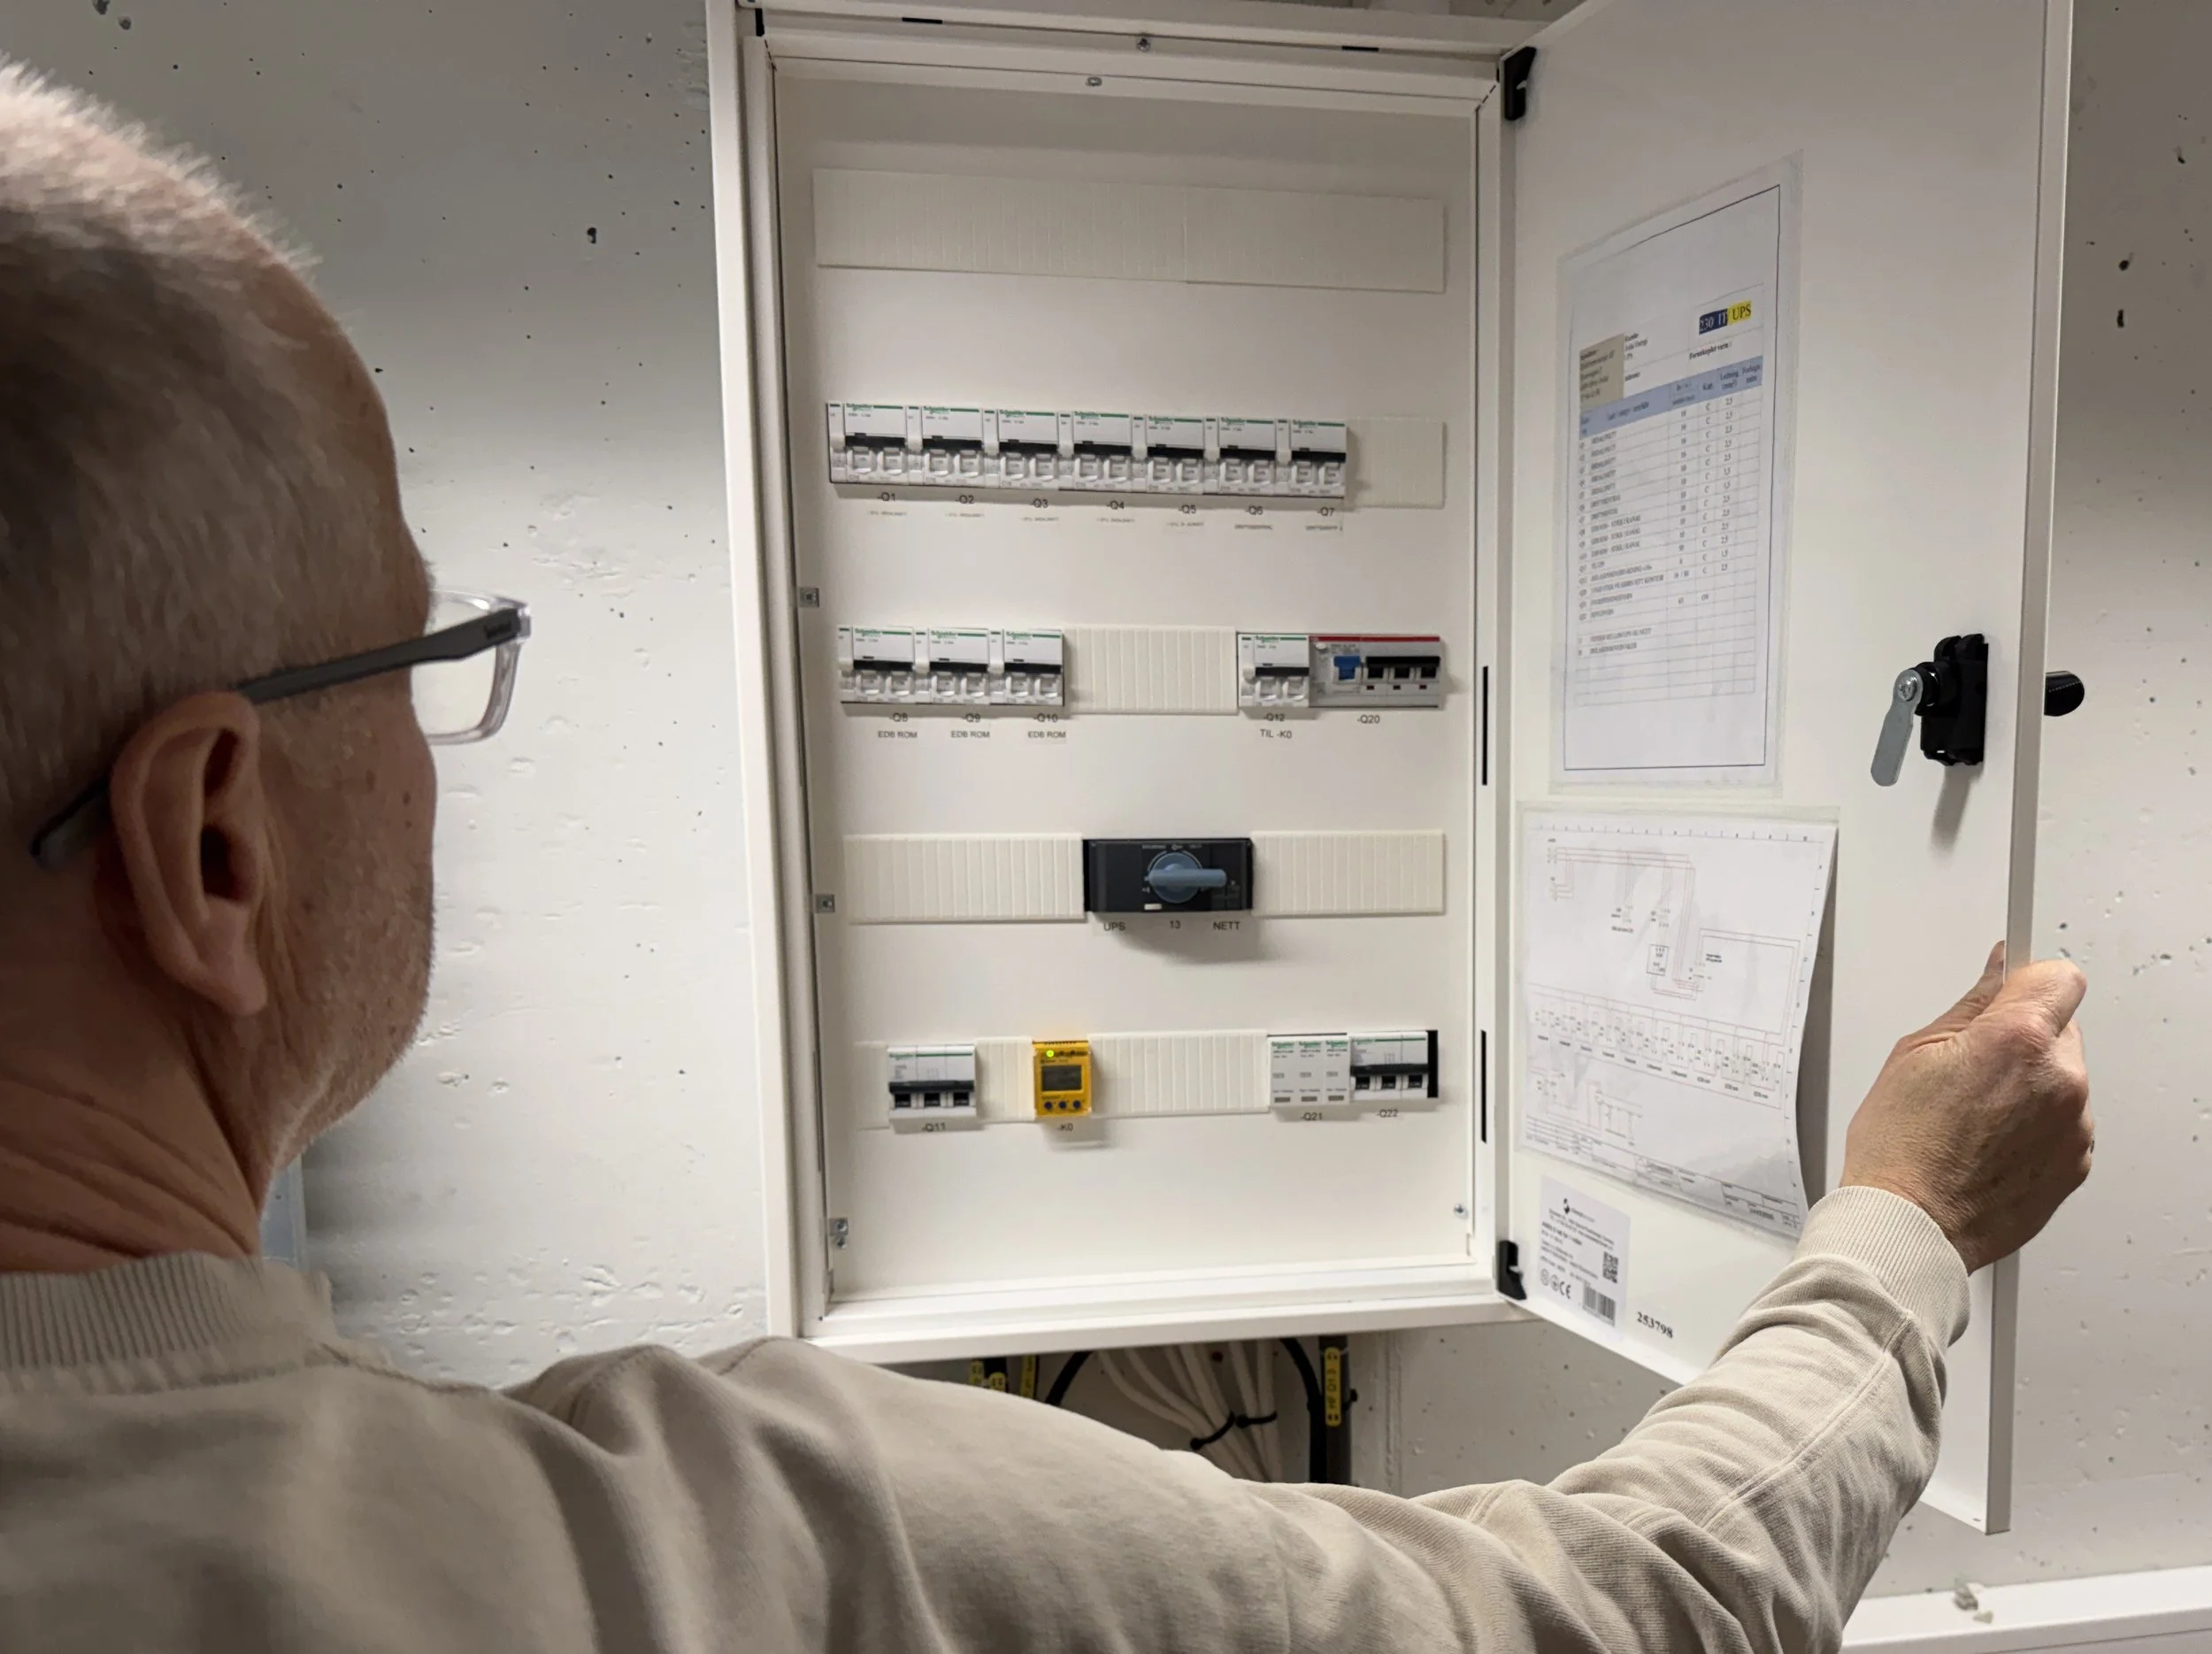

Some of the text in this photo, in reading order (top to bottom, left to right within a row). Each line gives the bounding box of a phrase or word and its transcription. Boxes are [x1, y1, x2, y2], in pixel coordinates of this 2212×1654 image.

[1700, 304, 1752, 331] 230 IT UPS
[1357, 714, 1380, 724] -Q20
[897, 730, 918, 739] ROM
[971, 730, 990, 739] ROM
[1260, 728, 1273, 738] TIL
[1103, 921, 1125, 932] UPS
[1170, 920, 1181, 929] 13
[1213, 921, 1240, 930] NETT
[1301, 1112, 1323, 1120] -Q21
[1377, 1109, 1398, 1118] -Q22
[1637, 1311, 1674, 1339] 253798
